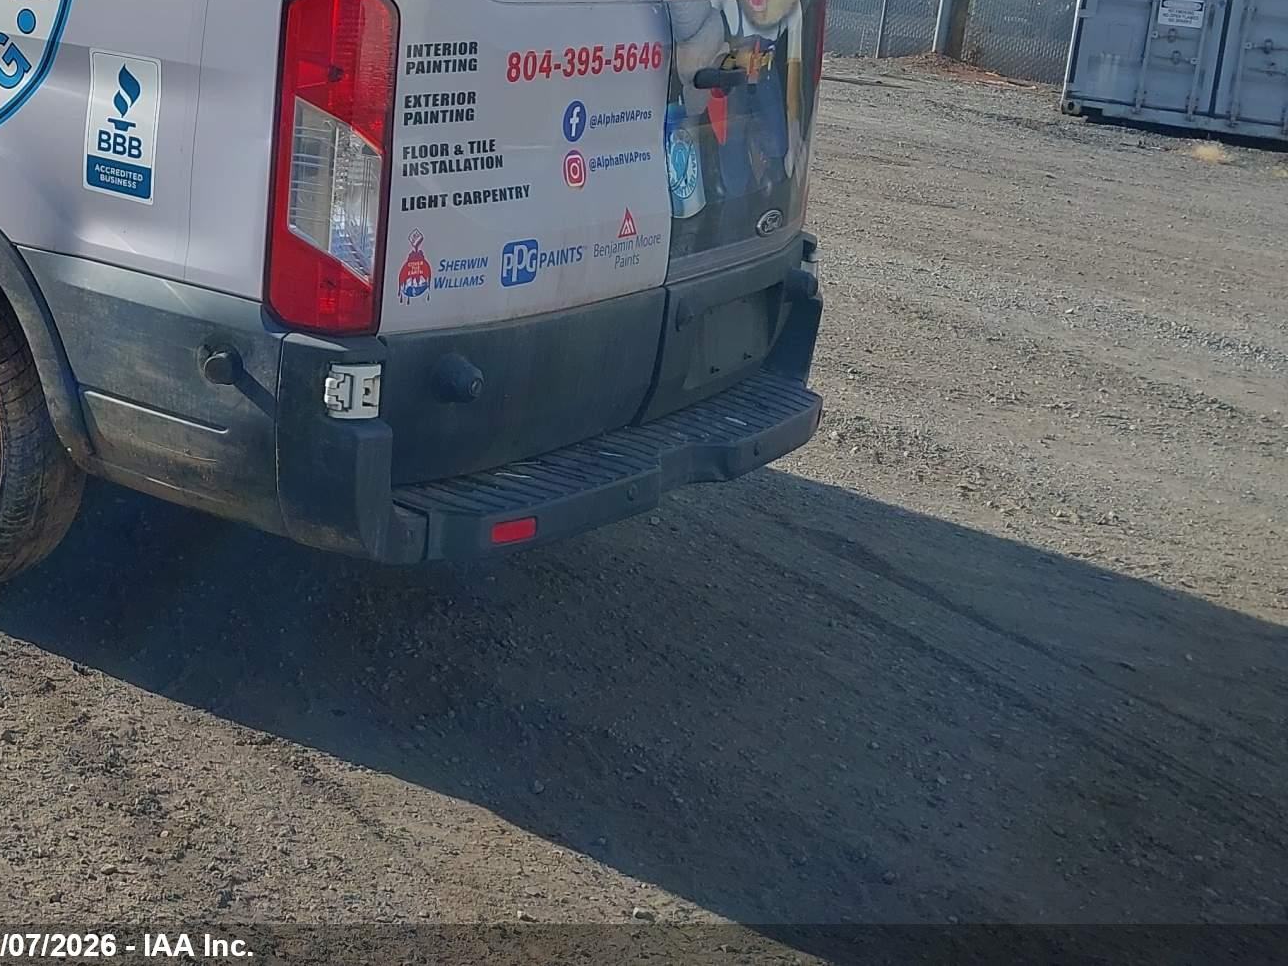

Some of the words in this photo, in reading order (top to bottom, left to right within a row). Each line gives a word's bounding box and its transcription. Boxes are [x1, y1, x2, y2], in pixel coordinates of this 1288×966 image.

[406, 41, 478, 59] INTERIOR
[405, 58, 478, 75] PAINTING
[507, 42, 662, 83] 804-395-5646
[404, 91, 476, 109] EXTERIOR
[403, 108, 475, 126] PAINTING
[589, 109, 652, 129] @AlphaRVAPros
[97, 130, 142, 159] BBB
[402, 143, 449, 160] FLOOR
[453, 144, 464, 156] &
[468, 139, 496, 154] TILE
[402, 155, 503, 177] INSTALLATION
[589, 151, 651, 171] @AlphaRVAPros
[95, 163, 143, 182] ACCREDITED
[100, 174, 137, 189] BUSINESS
[401, 194, 449, 212] LIGHT
[452, 185, 531, 206] CARPENTRY
[593, 240, 633, 258] Benjamin
[636, 234, 661, 247] Moore
[438, 256, 489, 272] SHERWIN
[503, 245, 538, 282] PPG
[539, 246, 583, 269] PAINTS
[615, 254, 640, 269] Paints
[434, 275, 485, 290] WILLIAMS
